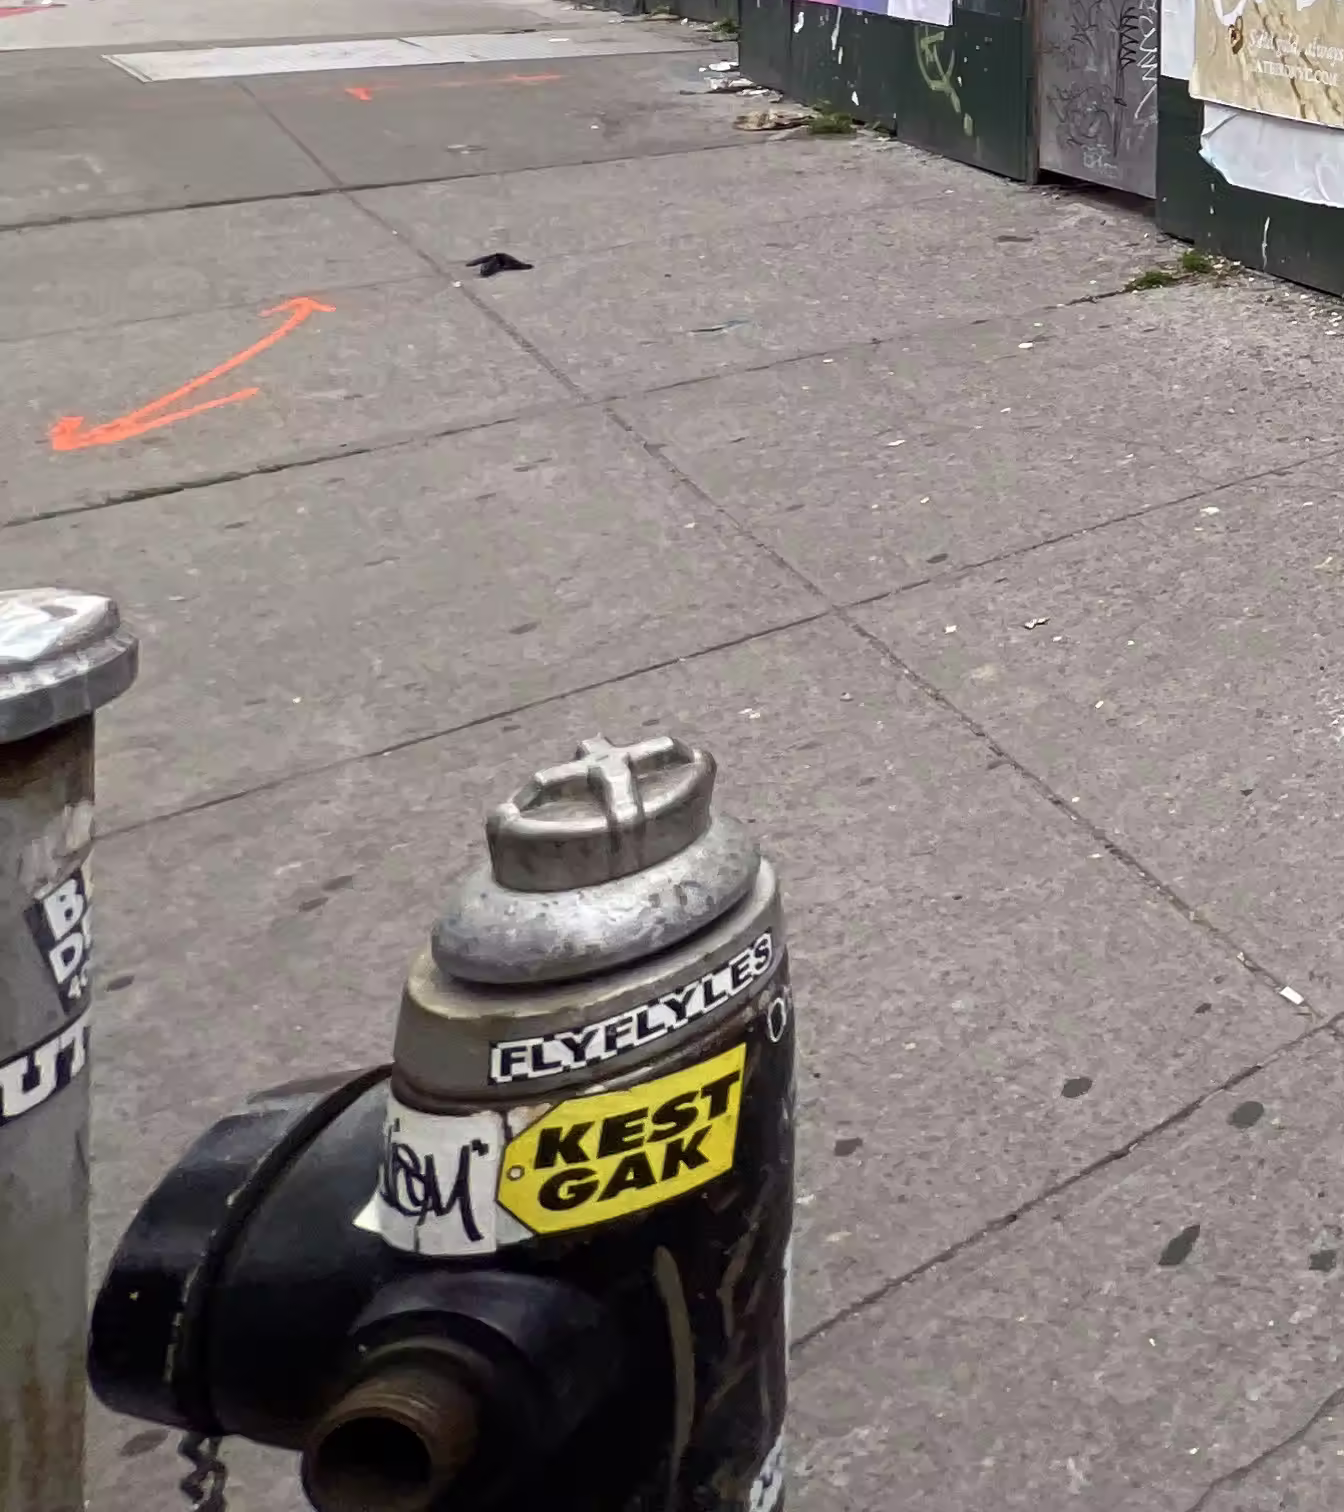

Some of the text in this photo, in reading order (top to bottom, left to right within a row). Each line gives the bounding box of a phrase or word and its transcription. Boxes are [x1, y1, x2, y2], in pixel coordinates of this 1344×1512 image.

[491, 933, 774, 1083] FLYFLYLES
[535, 1071, 742, 1170] KEST
[537, 1124, 715, 1212] GAK
